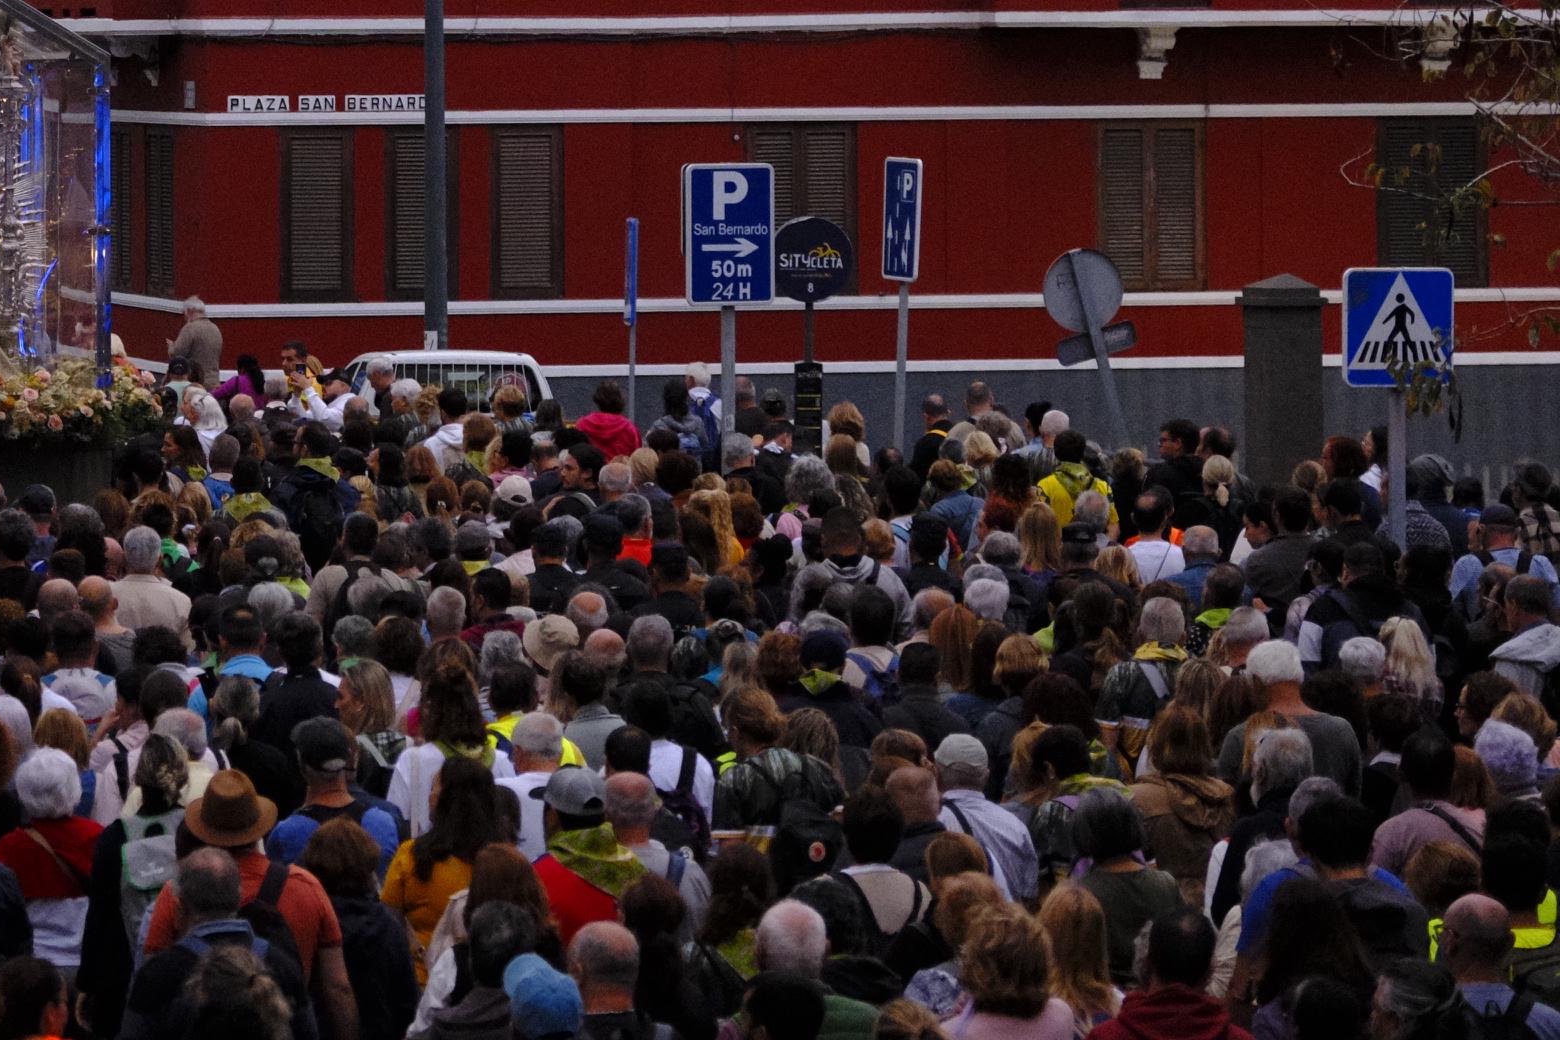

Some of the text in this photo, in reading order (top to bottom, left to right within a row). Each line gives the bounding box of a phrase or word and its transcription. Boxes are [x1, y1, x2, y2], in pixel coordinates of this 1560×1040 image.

[229, 96, 425, 111] PLAZA SAN BERNARD
[903, 172, 913, 198] P
[712, 170, 749, 221] P
[693, 222, 768, 236] San Bernardo
[711, 281, 751, 301] 24 H
[807, 282, 815, 293] 8
